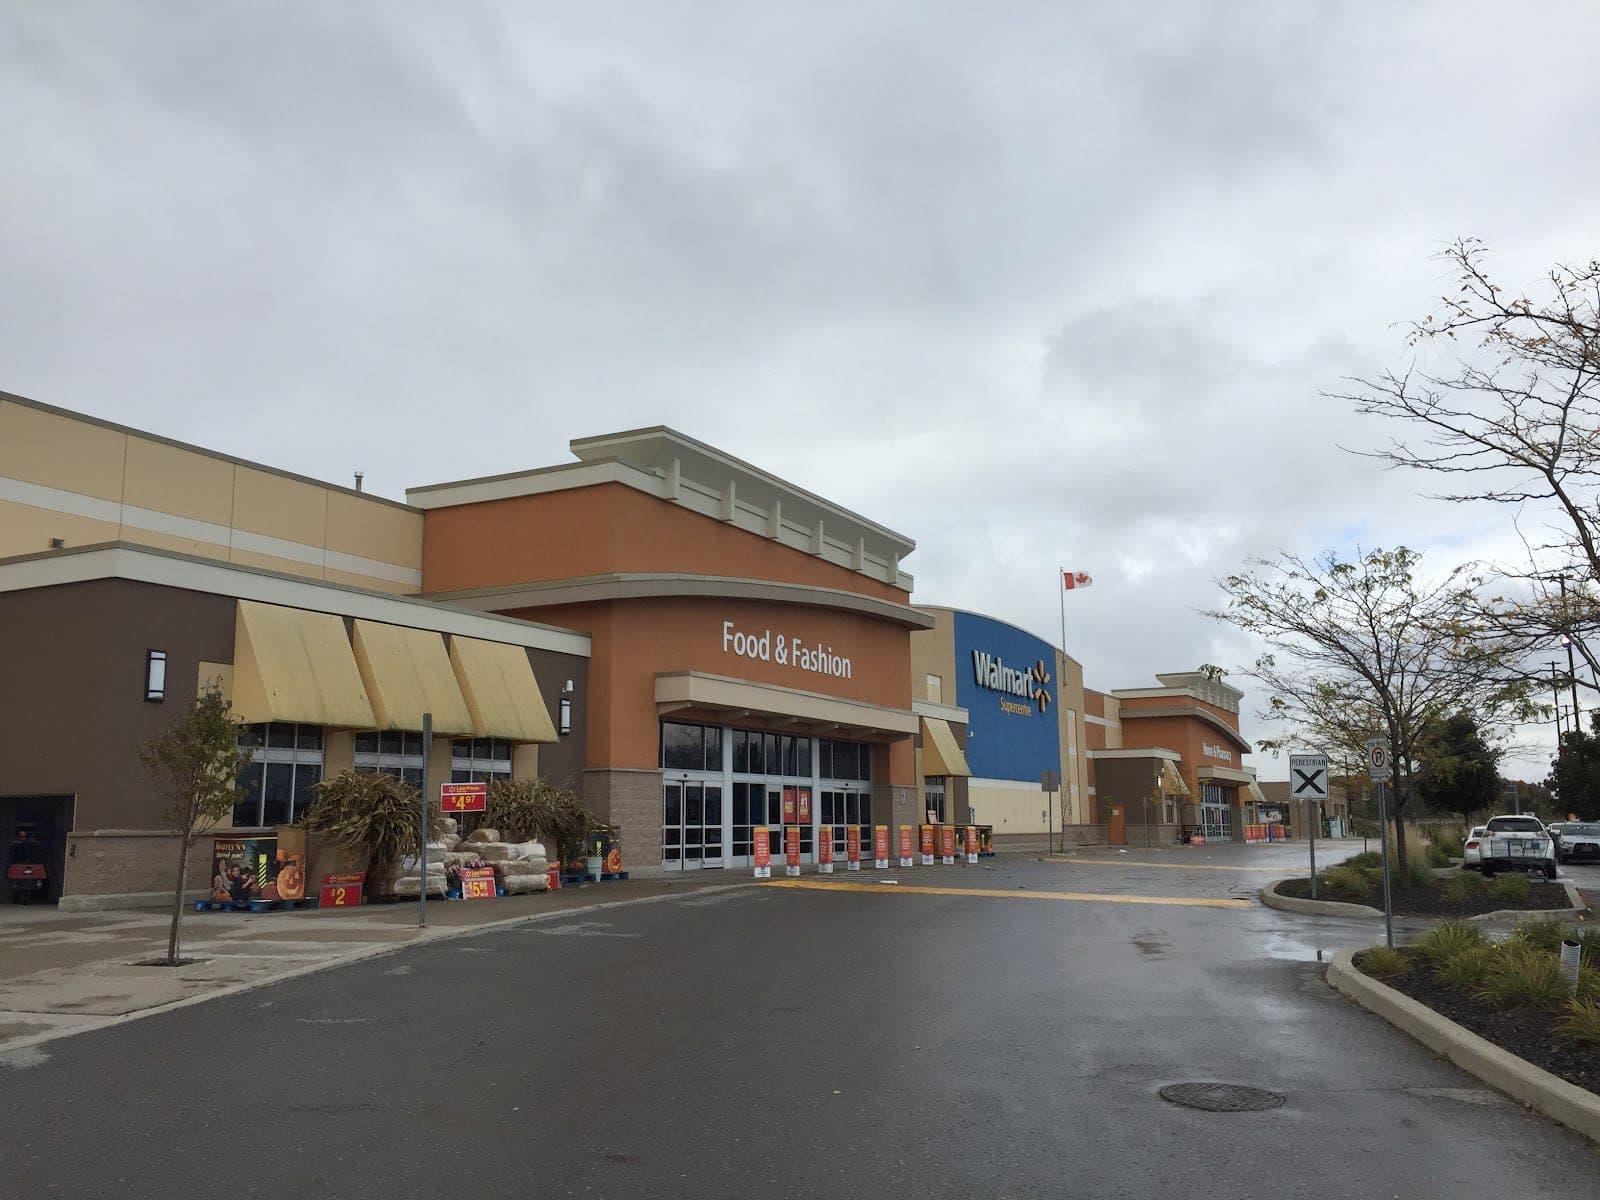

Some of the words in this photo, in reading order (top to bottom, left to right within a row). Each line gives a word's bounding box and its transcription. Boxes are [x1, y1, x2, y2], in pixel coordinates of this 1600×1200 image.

[723, 620, 770, 661] Food
[775, 634, 788, 665] &
[792, 638, 852, 679] Fashion
[973, 649, 1035, 699] Walmart
[1000, 697, 1032, 717] Supercentre
[1292, 759, 1326, 767] PEDESTRIAN
[330, 887, 346, 905] $2
